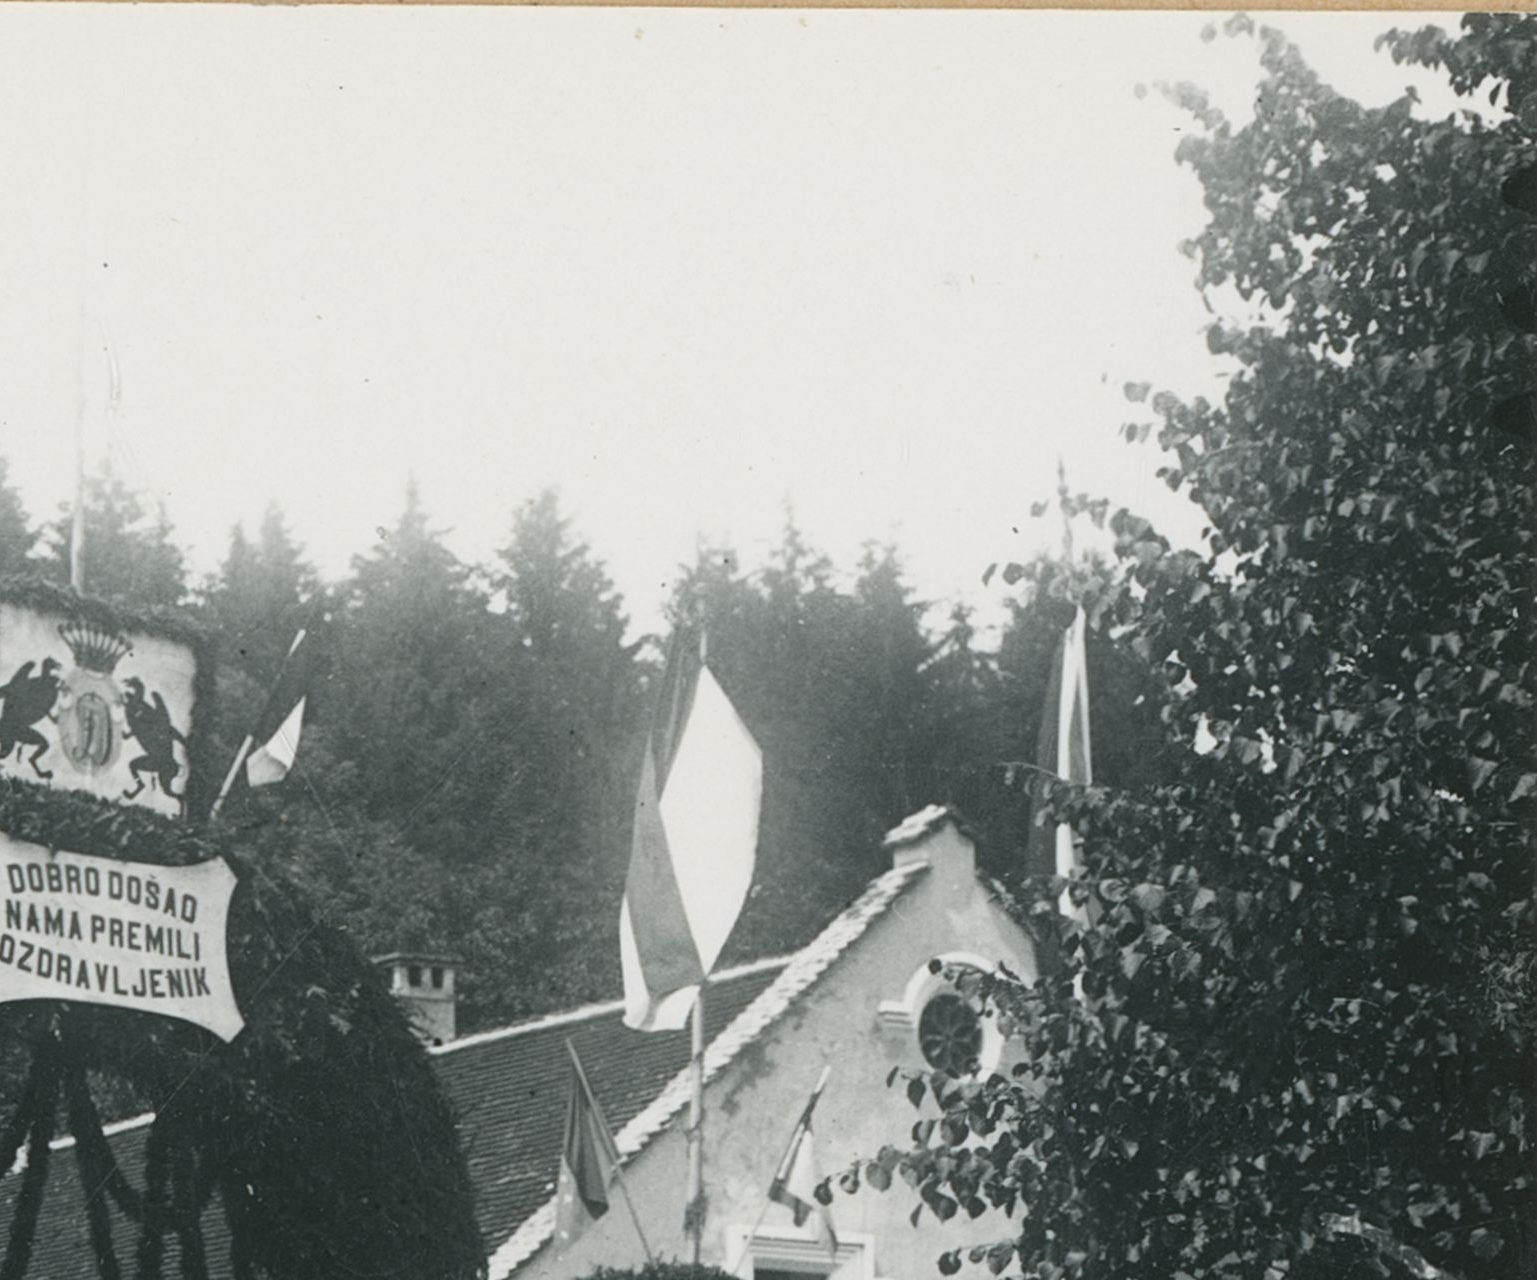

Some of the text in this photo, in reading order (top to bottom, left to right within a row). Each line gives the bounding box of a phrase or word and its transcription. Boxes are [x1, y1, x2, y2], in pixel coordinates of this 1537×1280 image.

[6, 862, 101, 897] DOBRO
[5, 899, 201, 962] NAMA PREMILI
